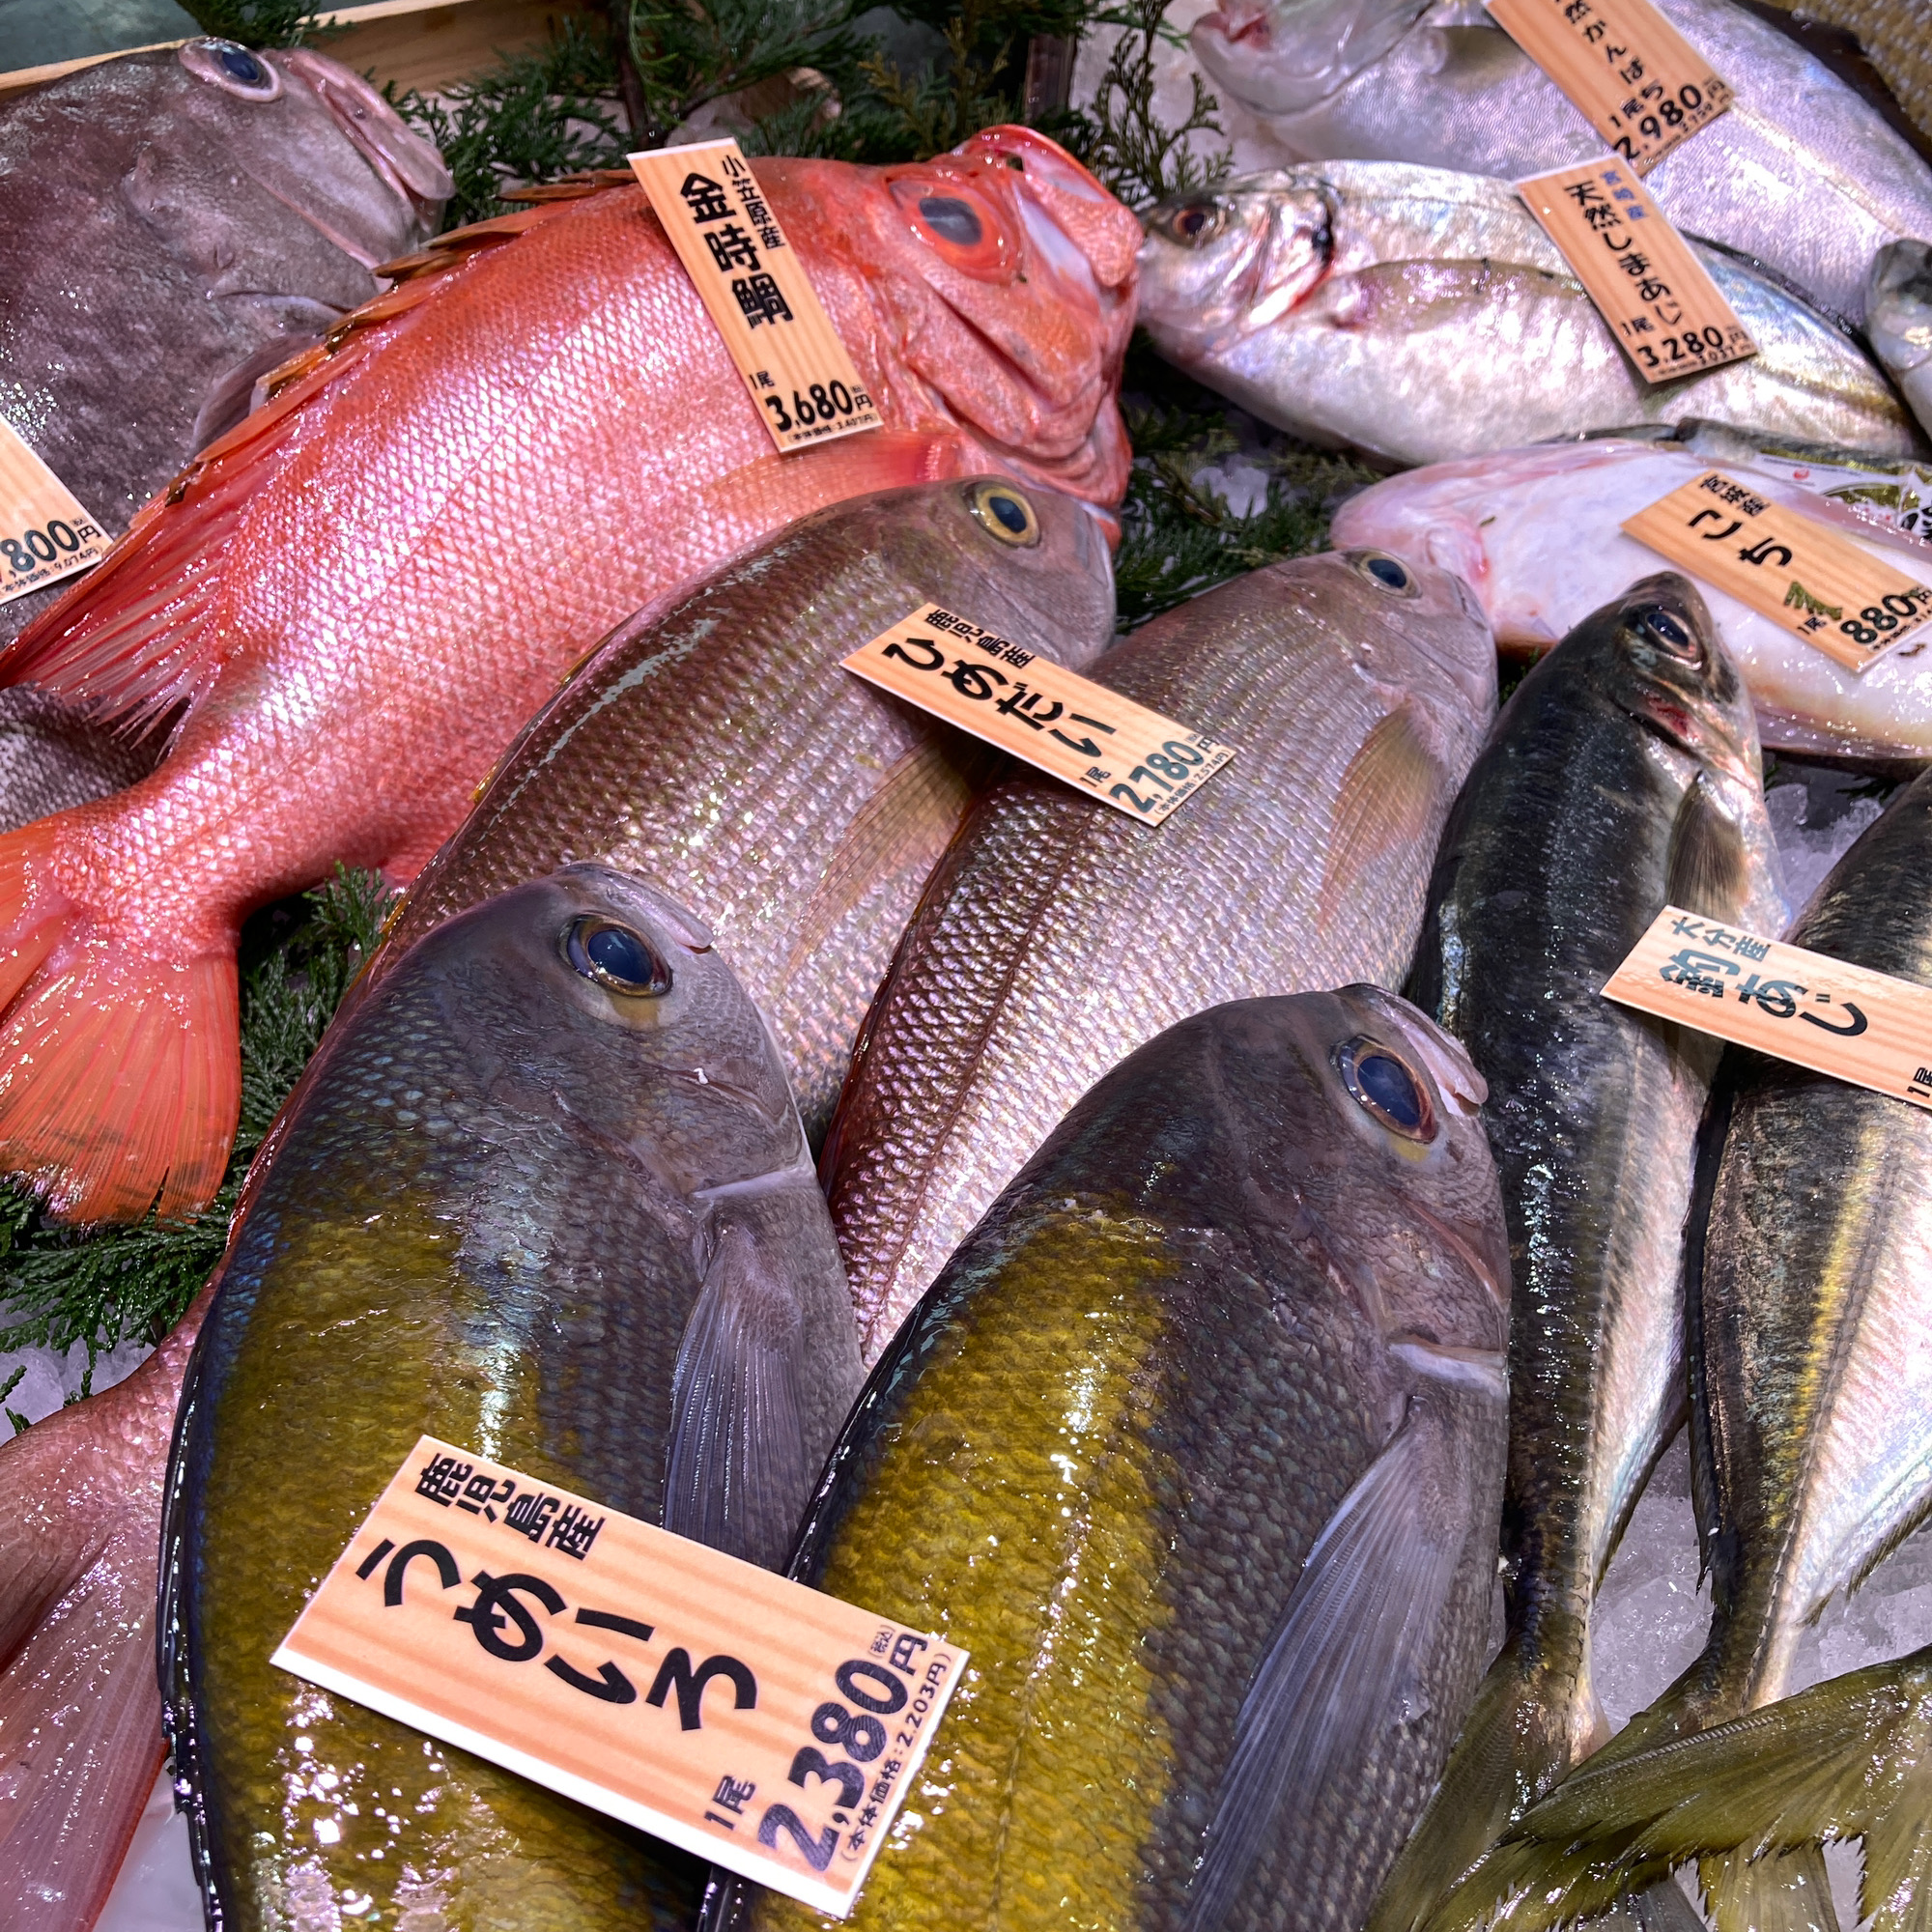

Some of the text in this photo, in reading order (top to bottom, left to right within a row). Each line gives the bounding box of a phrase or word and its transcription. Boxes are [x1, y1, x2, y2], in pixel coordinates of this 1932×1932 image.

[1608, 98, 1644, 128] 1尾
[721, 155, 785, 249] 小笠原産
[680, 172, 794, 329] 金時鯛
[1563, 180, 1683, 326] 天然しまあじ
[1621, 317, 1654, 337] 1尾
[749, 370, 776, 390] 1尾
[0, 520, 101, 583] ,800円
[1688, 509, 1793, 567] こち
[924, 609, 1037, 668] 鹿児島産
[1796, 616, 1828, 636] 1尾
[881, 637, 1118, 758] ひめだい
[1079, 766, 1112, 788] 1尾
[1670, 917, 1772, 962] 大分産
[1659, 949, 1868, 1037] 釣あじ
[413, 1453, 608, 1561] 鹿児島産
[355, 1538, 761, 1732] うめいろ
[757, 1634, 928, 1872] 2,380円
[703, 1775, 756, 1832] 1尾
